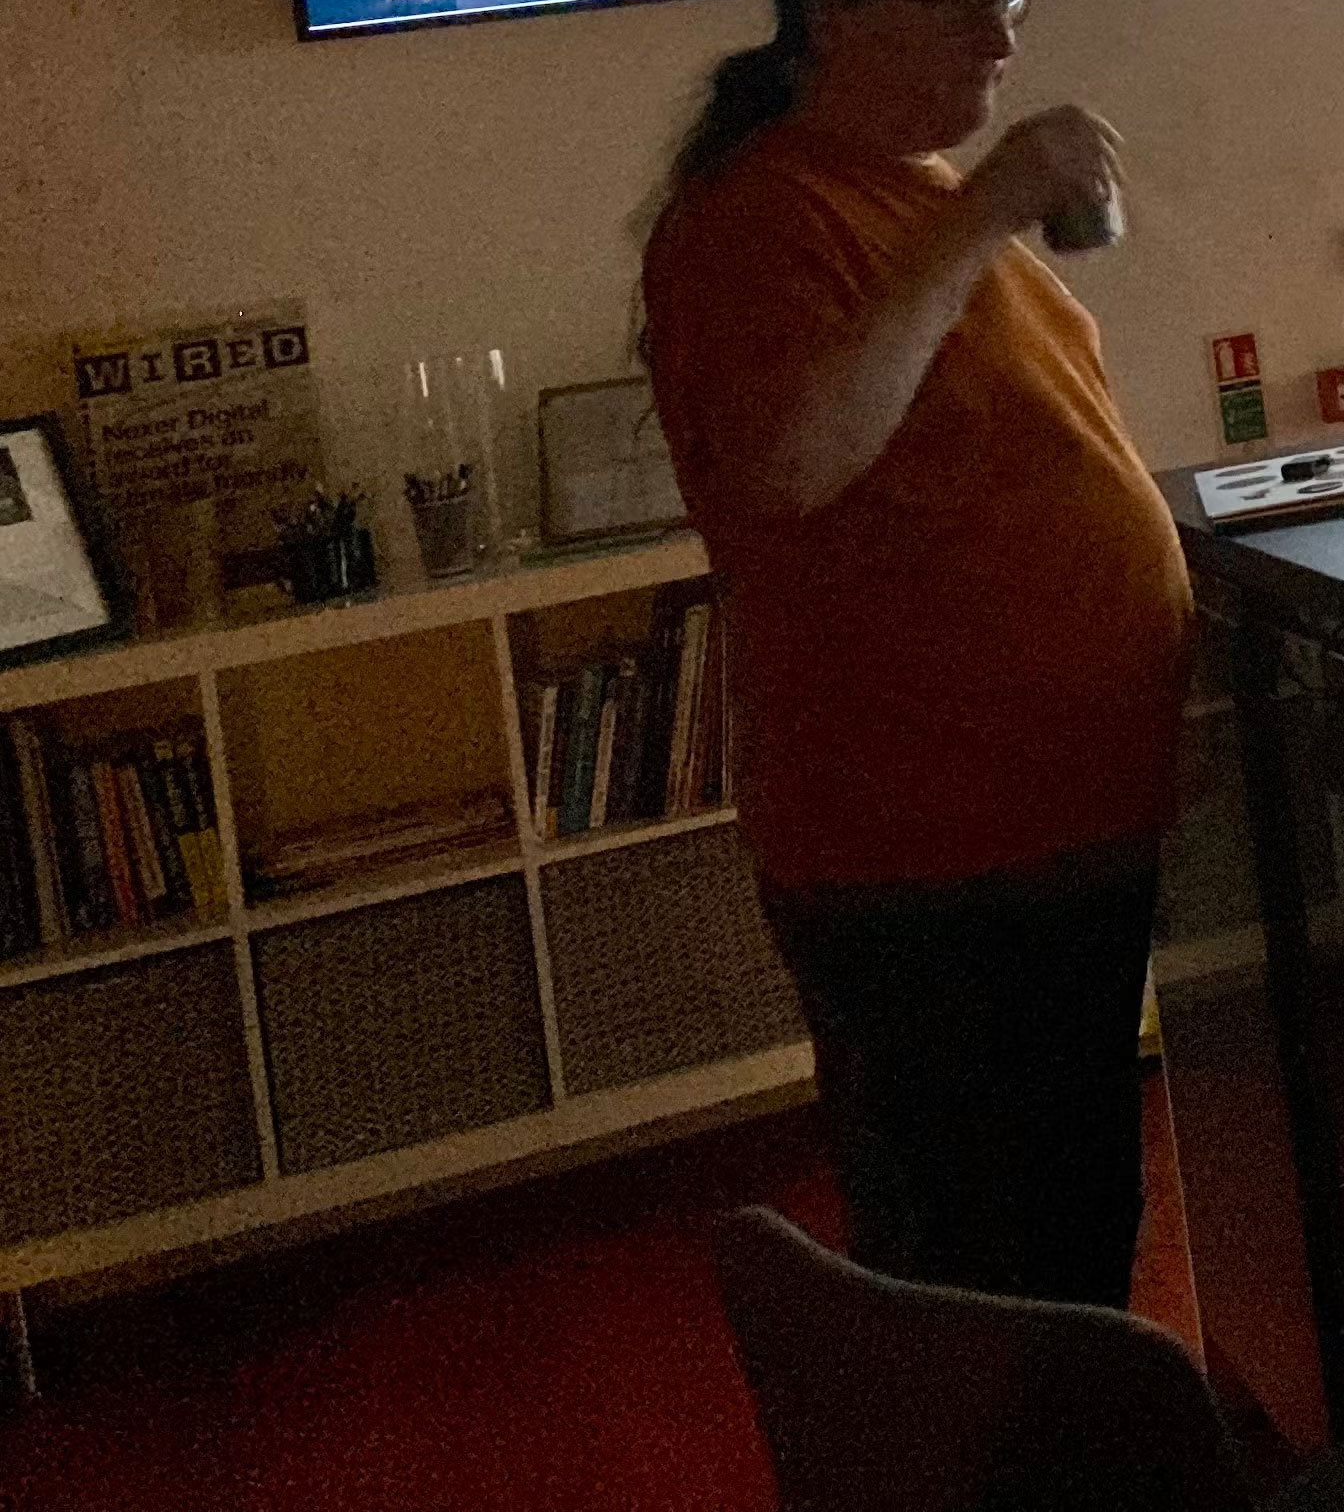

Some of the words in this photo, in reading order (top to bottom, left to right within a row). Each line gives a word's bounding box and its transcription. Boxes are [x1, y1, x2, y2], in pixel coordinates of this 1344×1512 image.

[73, 326, 310, 400] WIRED
[101, 413, 180, 442] Nexer
[186, 398, 271, 431] Digital
